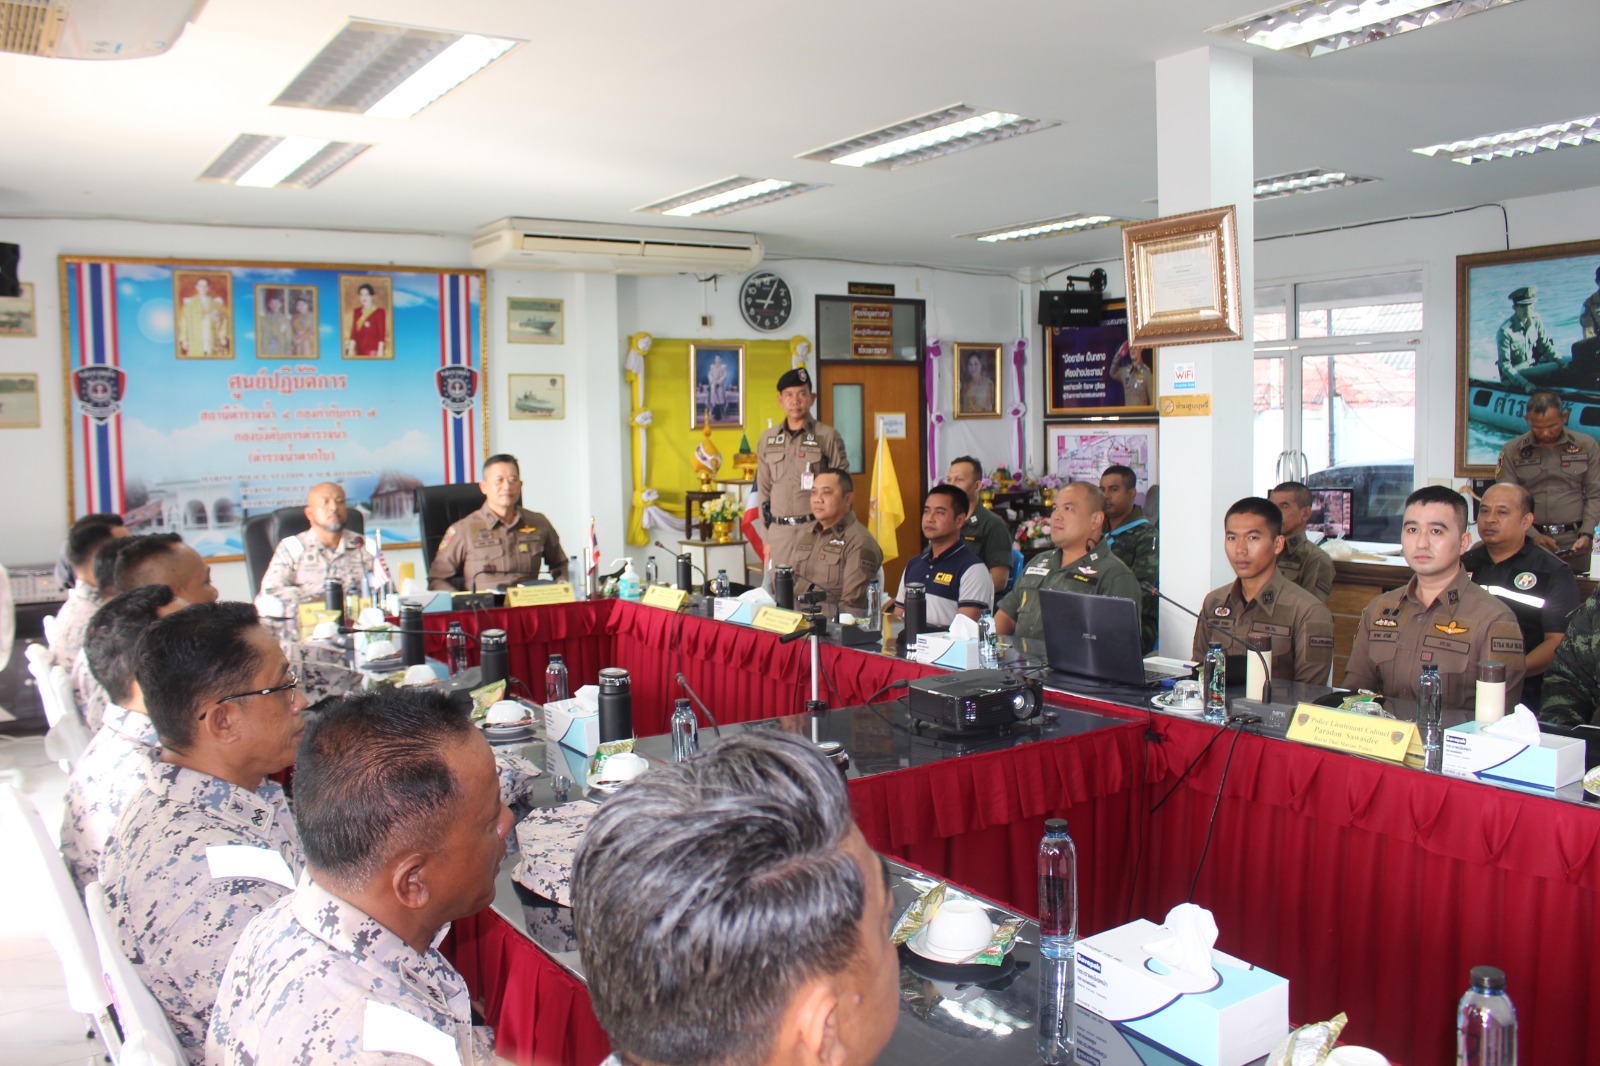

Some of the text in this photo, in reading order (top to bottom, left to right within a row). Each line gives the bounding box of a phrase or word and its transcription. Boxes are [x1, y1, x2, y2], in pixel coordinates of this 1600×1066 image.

[748, 287, 757, 295] 10
[782, 299, 787, 307] 3
[765, 318, 770, 327] 6
[1175, 370, 1194, 380] WiFi
[229, 365, 347, 400] ศูนย์ปฏิบัติการ
[1175, 399, 1209, 411] ห้ามสูบบุหรี่
[935, 571, 953, 583] CIB
[1311, 716, 1390, 738] Police Lieutenant Colonel
[1314, 726, 1380, 745] Paradon Sawasdee
